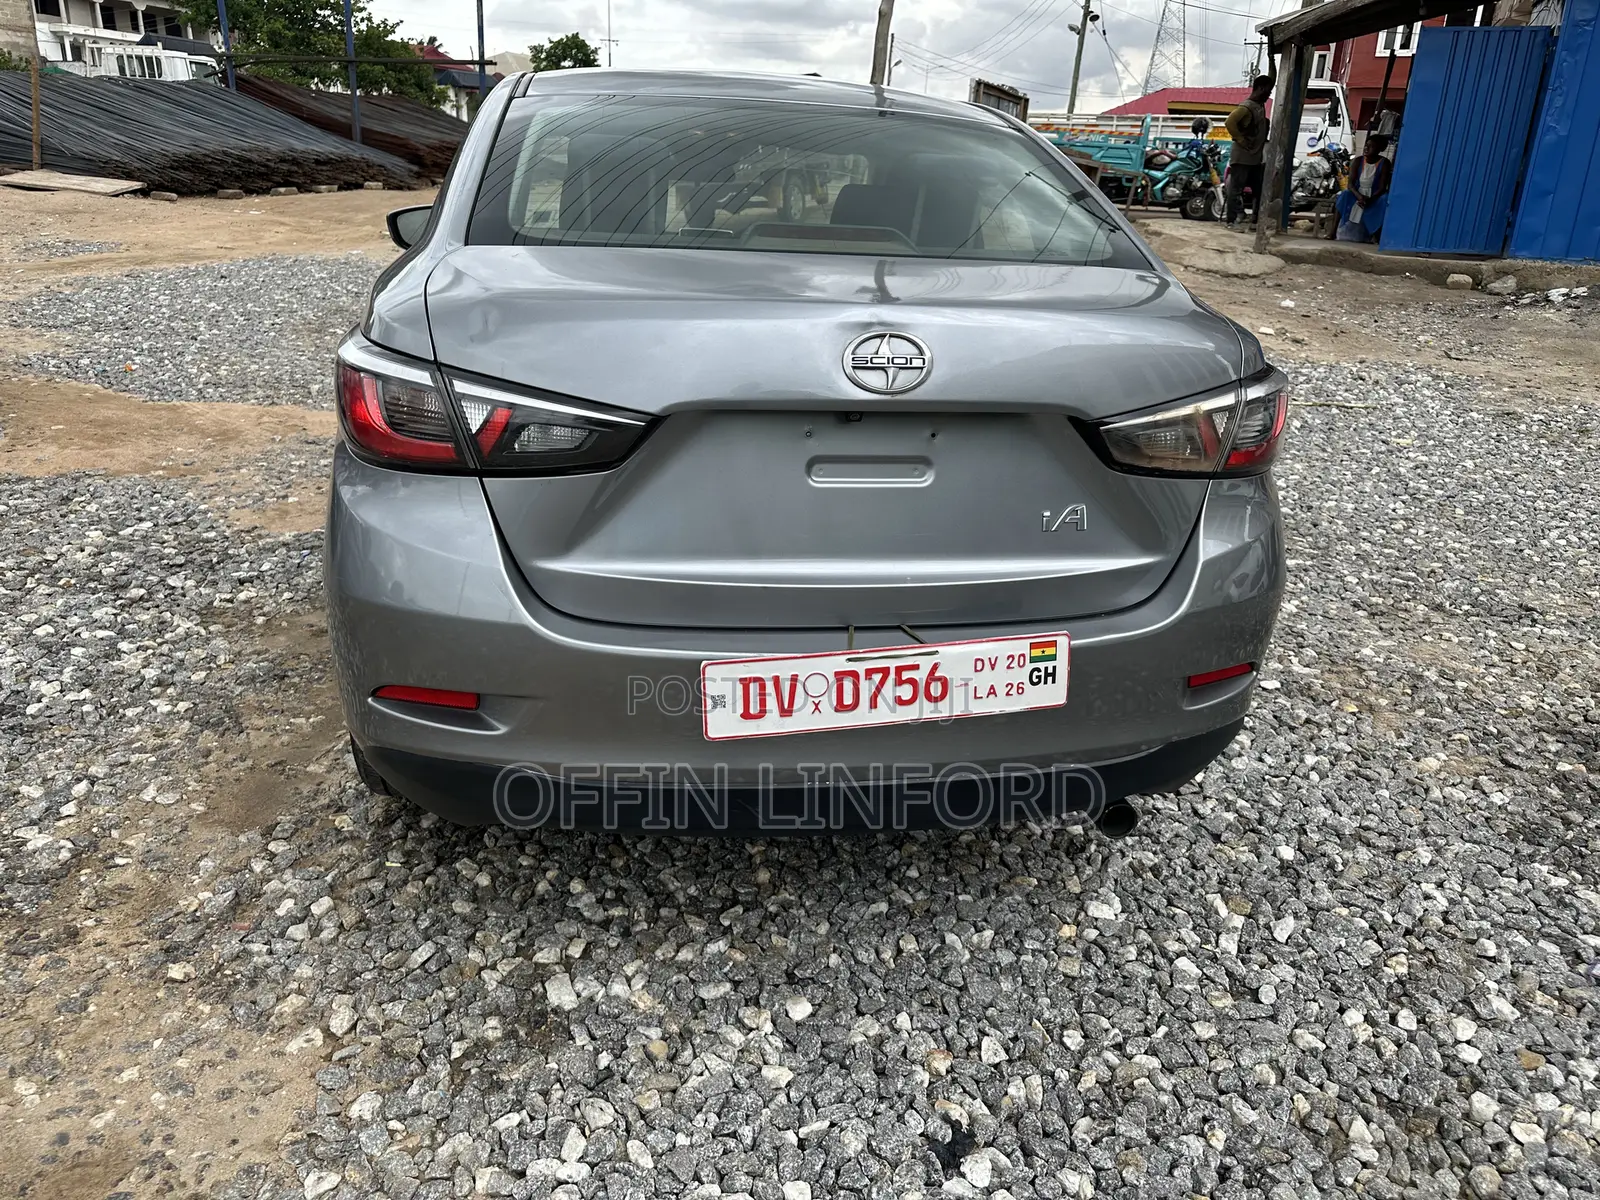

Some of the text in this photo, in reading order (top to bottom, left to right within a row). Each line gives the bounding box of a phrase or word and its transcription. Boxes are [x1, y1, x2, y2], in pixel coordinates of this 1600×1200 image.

[851, 355, 926, 367] SCION
[1041, 503, 1088, 532] iA
[974, 653, 1027, 672] DV 20
[1029, 666, 1057, 687] GH
[739, 662, 949, 720] DV D756
[973, 682, 1025, 700] LA 26
